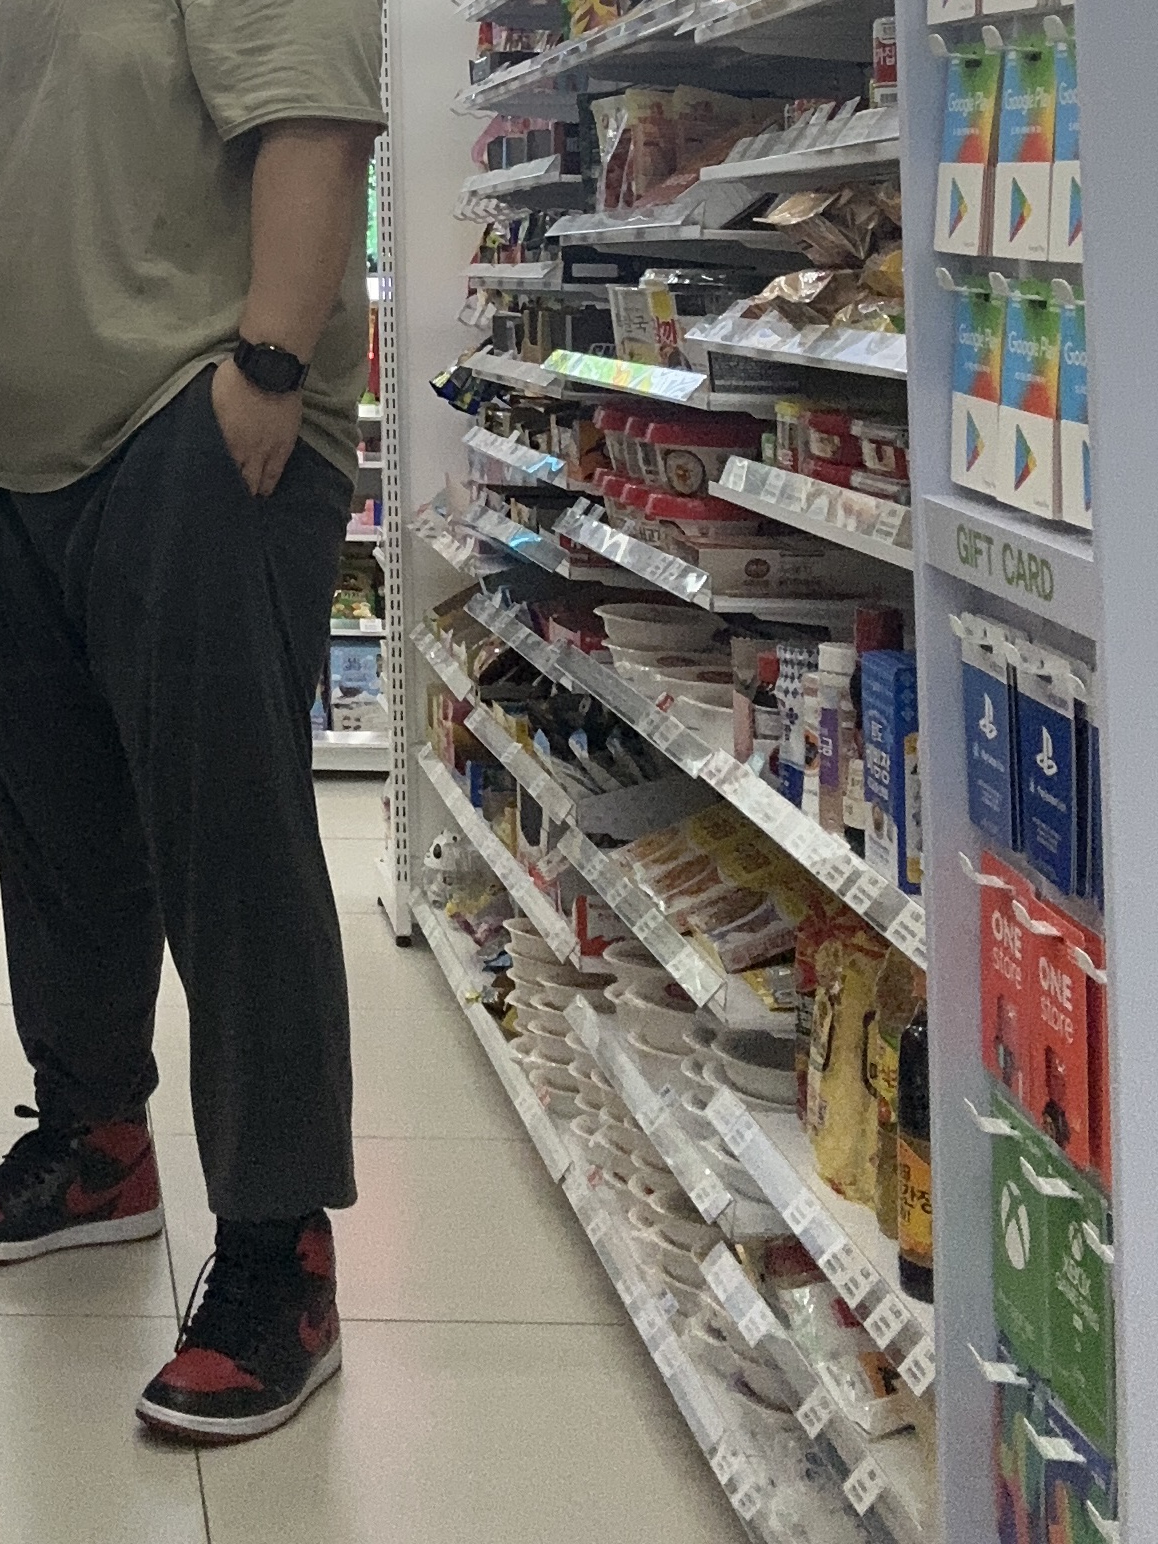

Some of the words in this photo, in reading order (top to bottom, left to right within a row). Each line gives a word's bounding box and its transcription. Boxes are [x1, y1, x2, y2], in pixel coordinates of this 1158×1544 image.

[957, 523, 994, 578] GIFT
[1002, 541, 1055, 602] CARD
[992, 909, 1022, 961] ONE
[1038, 956, 1073, 1012] ONE
